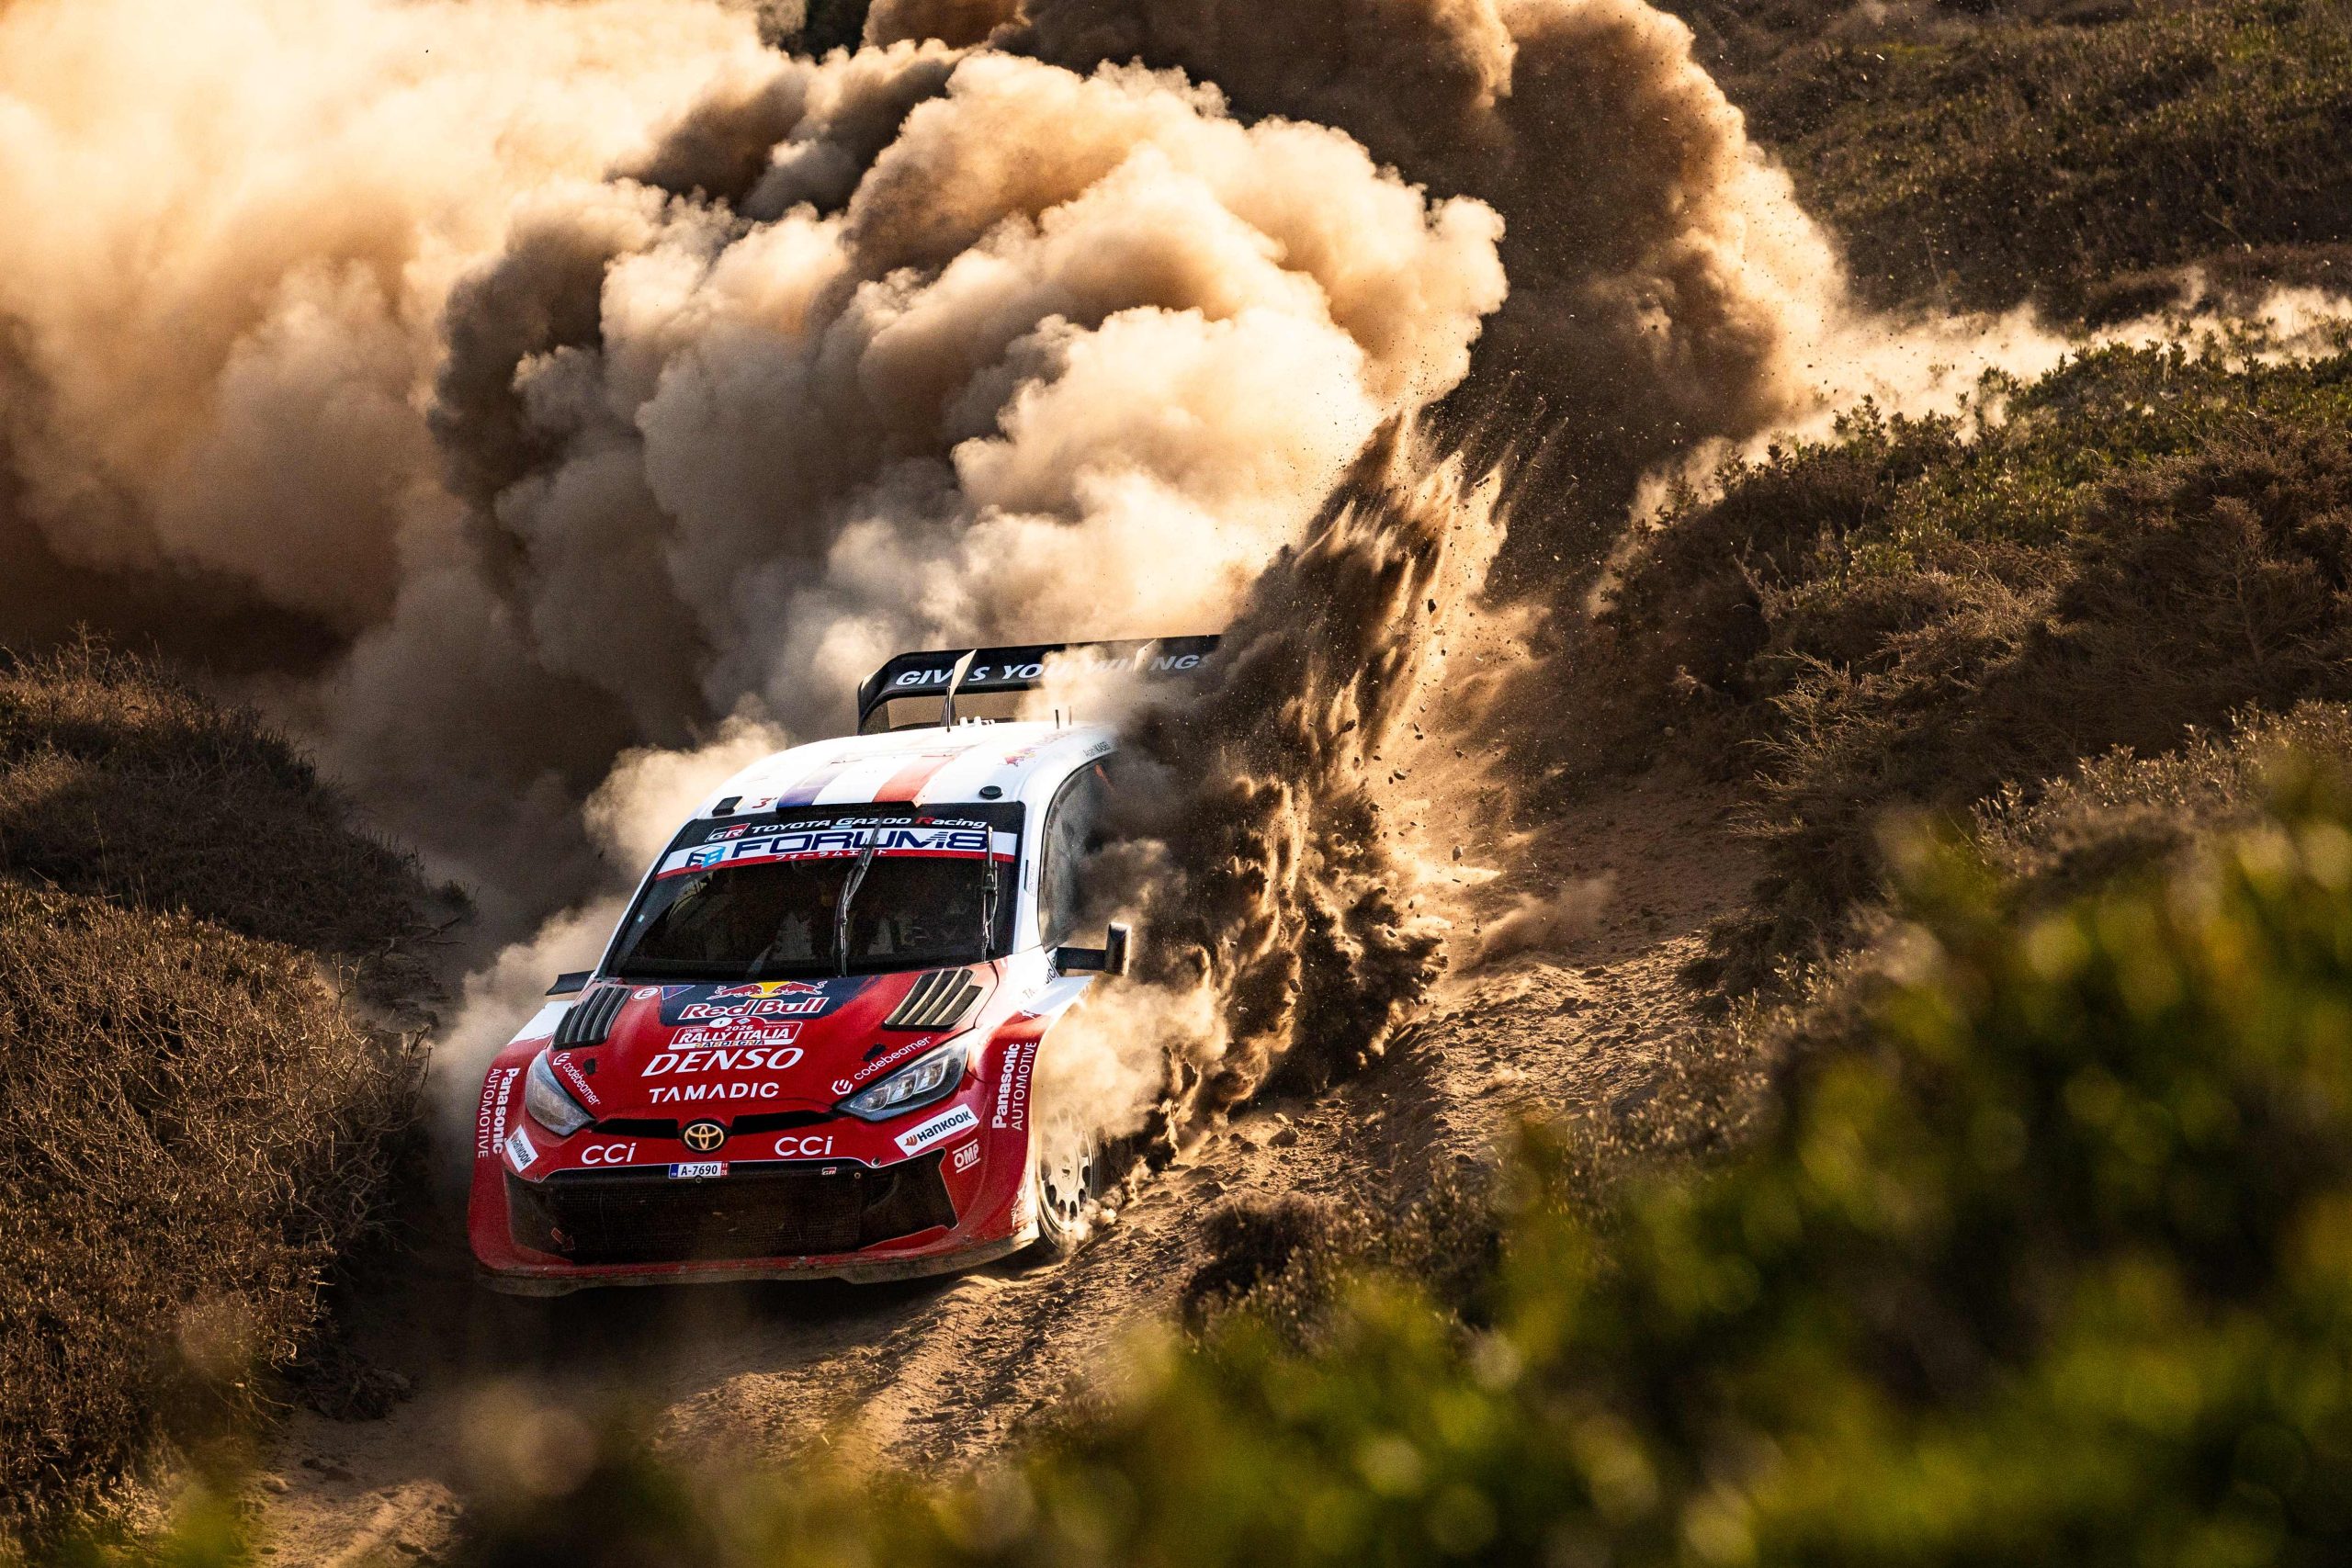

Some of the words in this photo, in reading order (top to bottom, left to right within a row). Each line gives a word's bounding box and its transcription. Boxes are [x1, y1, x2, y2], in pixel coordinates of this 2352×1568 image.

[896, 666, 990, 685] GIVS
[707, 828, 744, 841] GR
[752, 819, 831, 834] TOYOTA
[835, 817, 912, 826] GAZOO
[915, 817, 988, 829] Racing
[731, 830, 989, 858] FORUM8
[775, 849, 888, 861] フォーラムエト
[678, 999, 755, 1020] Red
[752, 997, 830, 1016] Bull
[678, 1031, 733, 1043] RALLY
[735, 1028, 789, 1041] ITALIA
[695, 1040, 765, 1049] SARDEGNA
[641, 1047, 804, 1077] DENSO
[854, 1035, 929, 1081] codebeamer
[563, 1062, 599, 1105] codebeamer
[649, 1081, 779, 1103] TAMADIC
[991, 1043, 1021, 1129] Panasonic
[1012, 1042, 1037, 1132] AUTOMOTIVE
[478, 1067, 503, 1158] AUTOMOTIVE
[492, 1066, 520, 1155] Panasonic
[954, 1143, 979, 1168] OMP
[681, 1165, 718, 1177] A-7690
